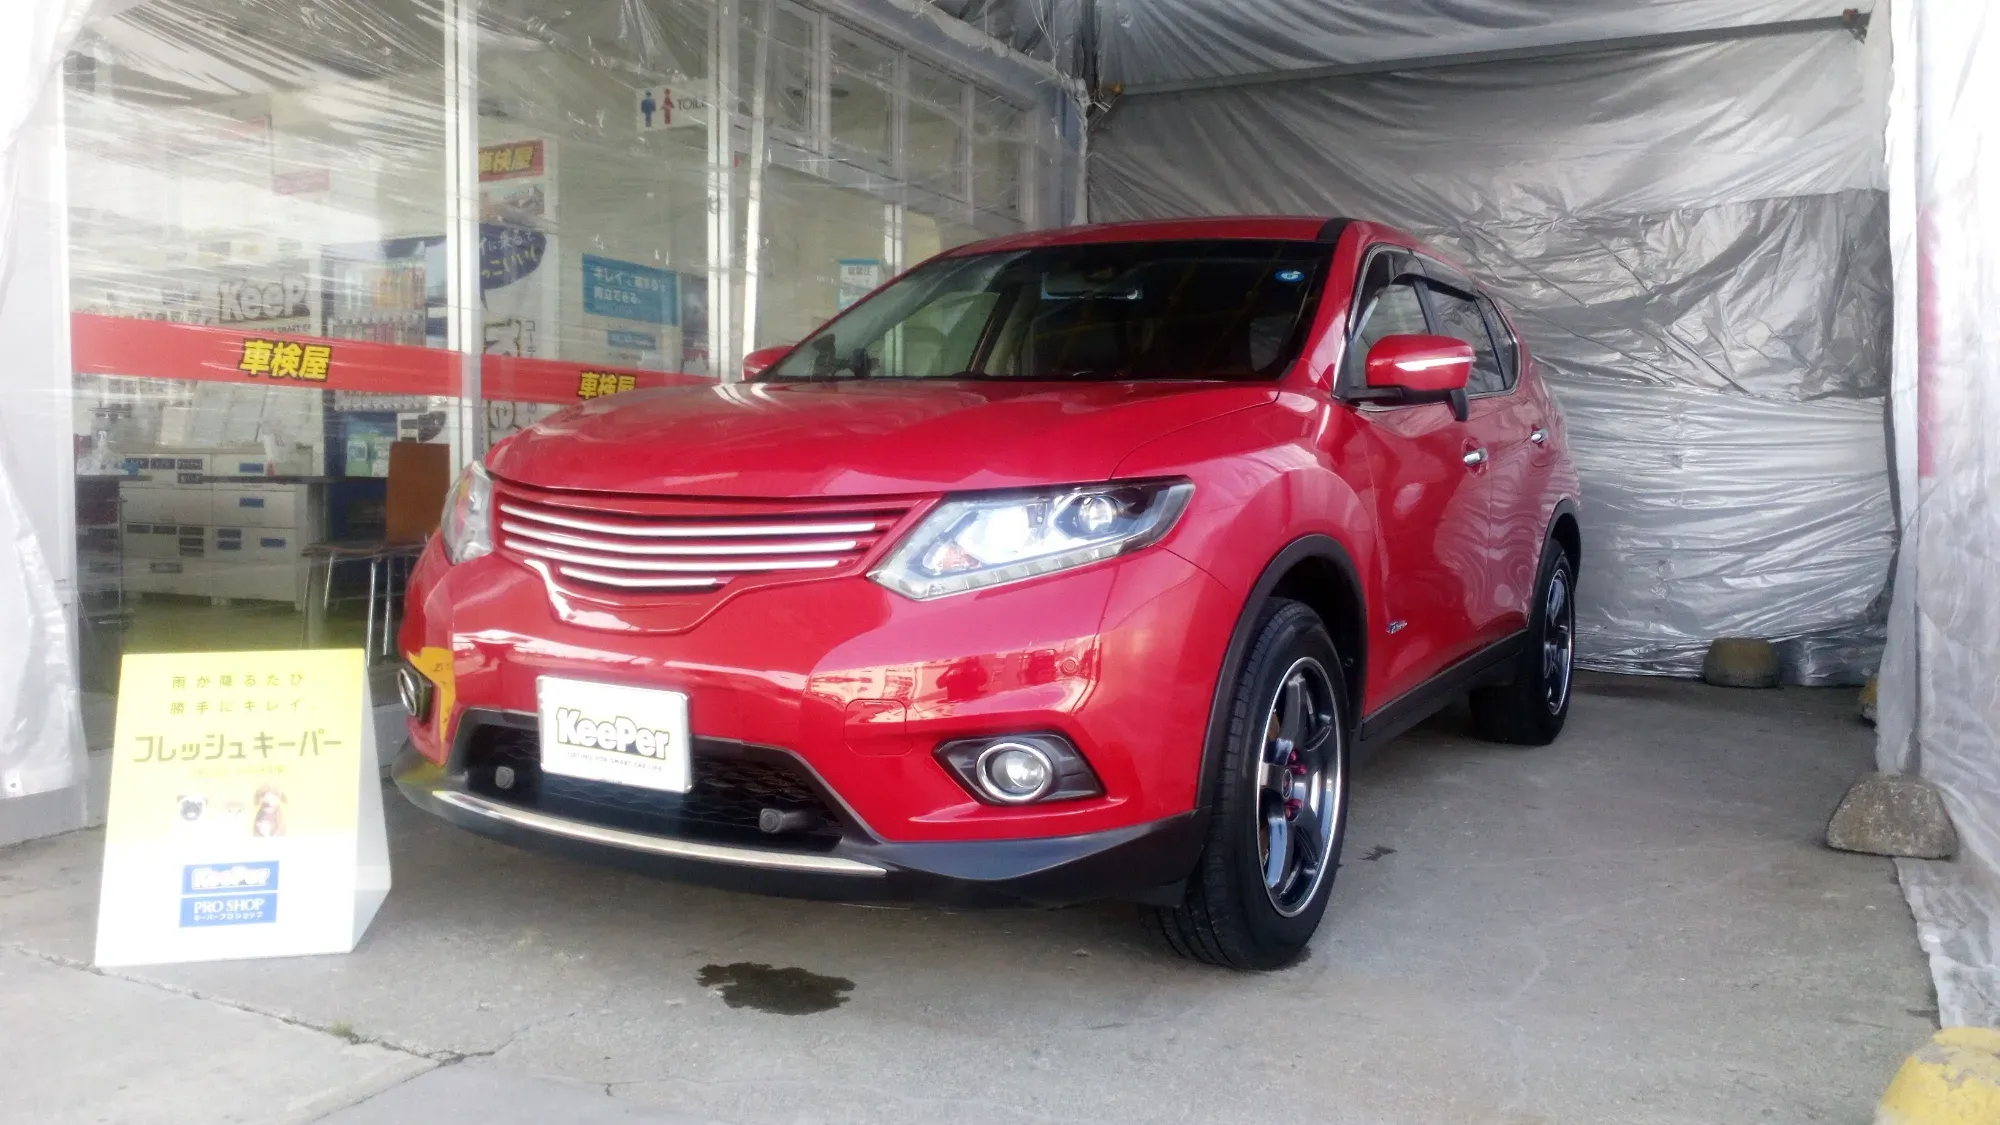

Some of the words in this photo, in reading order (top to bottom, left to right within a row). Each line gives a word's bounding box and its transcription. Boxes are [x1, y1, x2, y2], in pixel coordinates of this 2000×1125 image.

[238, 338, 330, 381] 車検屋
[577, 371, 636, 400] 車検屋
[133, 728, 343, 764] フレッシュキーパー
[556, 707, 671, 761] KeePer
[194, 899, 224, 914] PRO
[226, 897, 265, 912] SHOP
